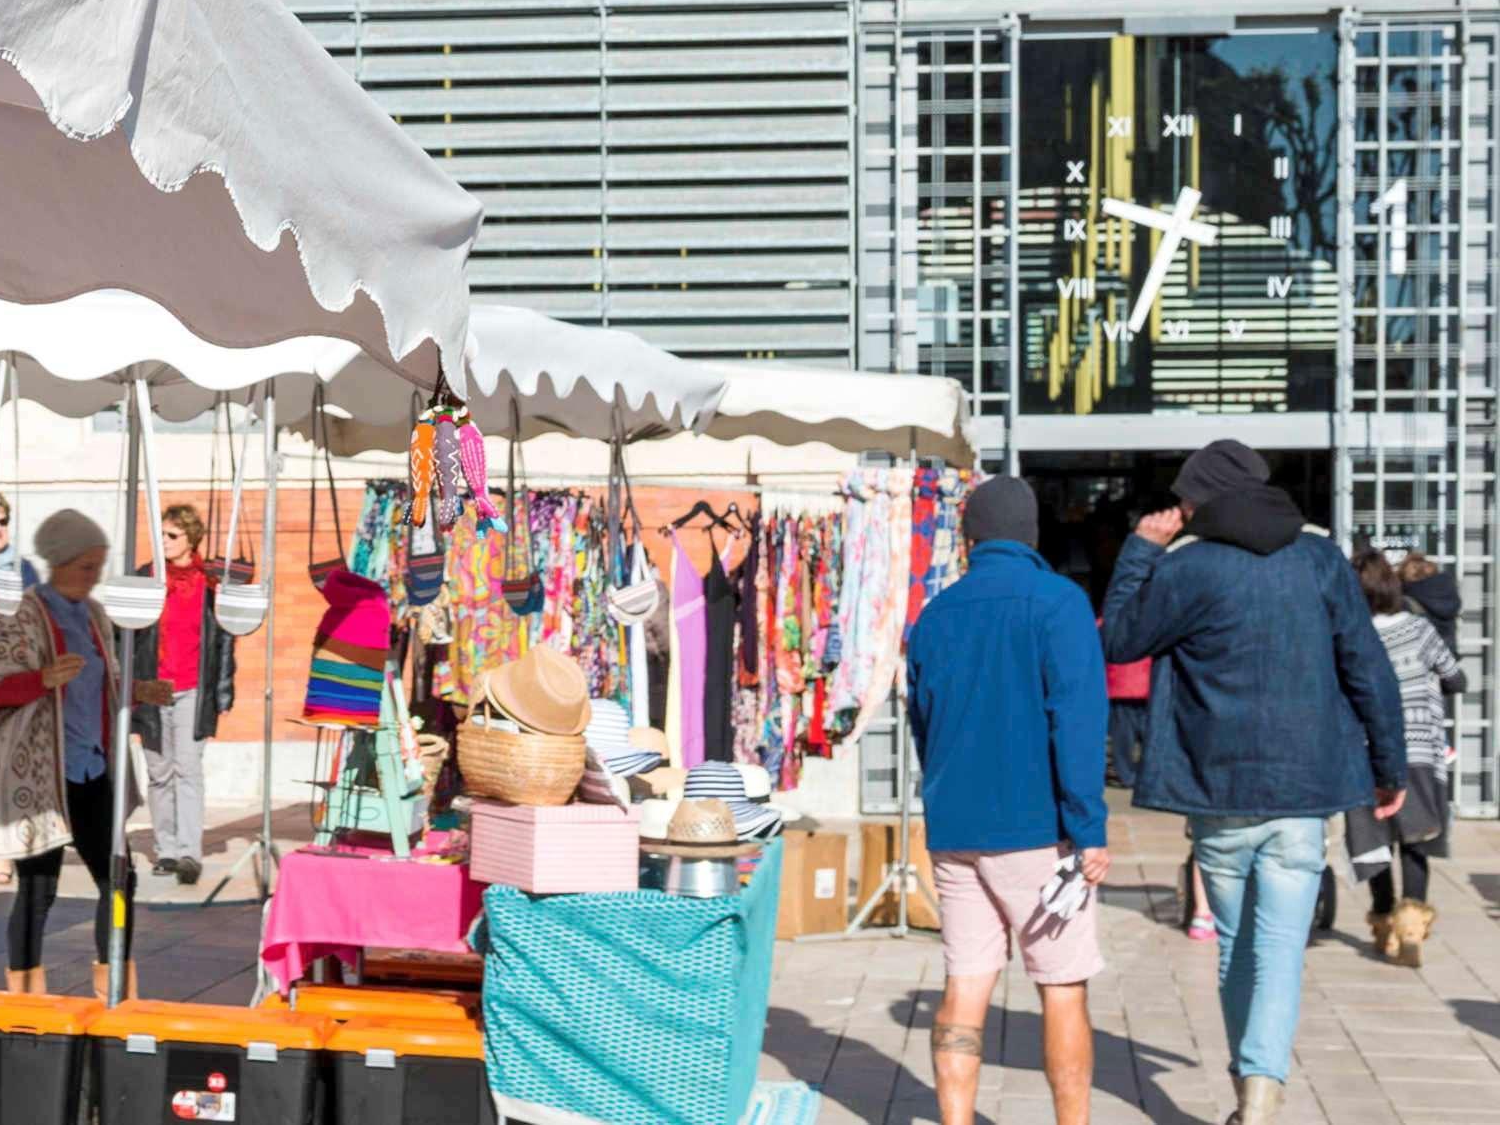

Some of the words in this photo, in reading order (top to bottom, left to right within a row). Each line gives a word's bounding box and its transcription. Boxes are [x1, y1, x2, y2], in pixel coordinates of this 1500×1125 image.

[1107, 116, 1132, 137] XI
[1162, 114, 1194, 137] XII
[1234, 113, 1242, 137] I
[1066, 160, 1085, 184] X
[1274, 156, 1289, 180] II
[1064, 218, 1086, 241] IX
[1270, 215, 1292, 238] III
[1370, 178, 1407, 275] 1
[1057, 277, 1095, 300] VIII
[1267, 275, 1293, 299] IV
[1164, 319, 1190, 341] VI
[1228, 319, 1246, 341] V
